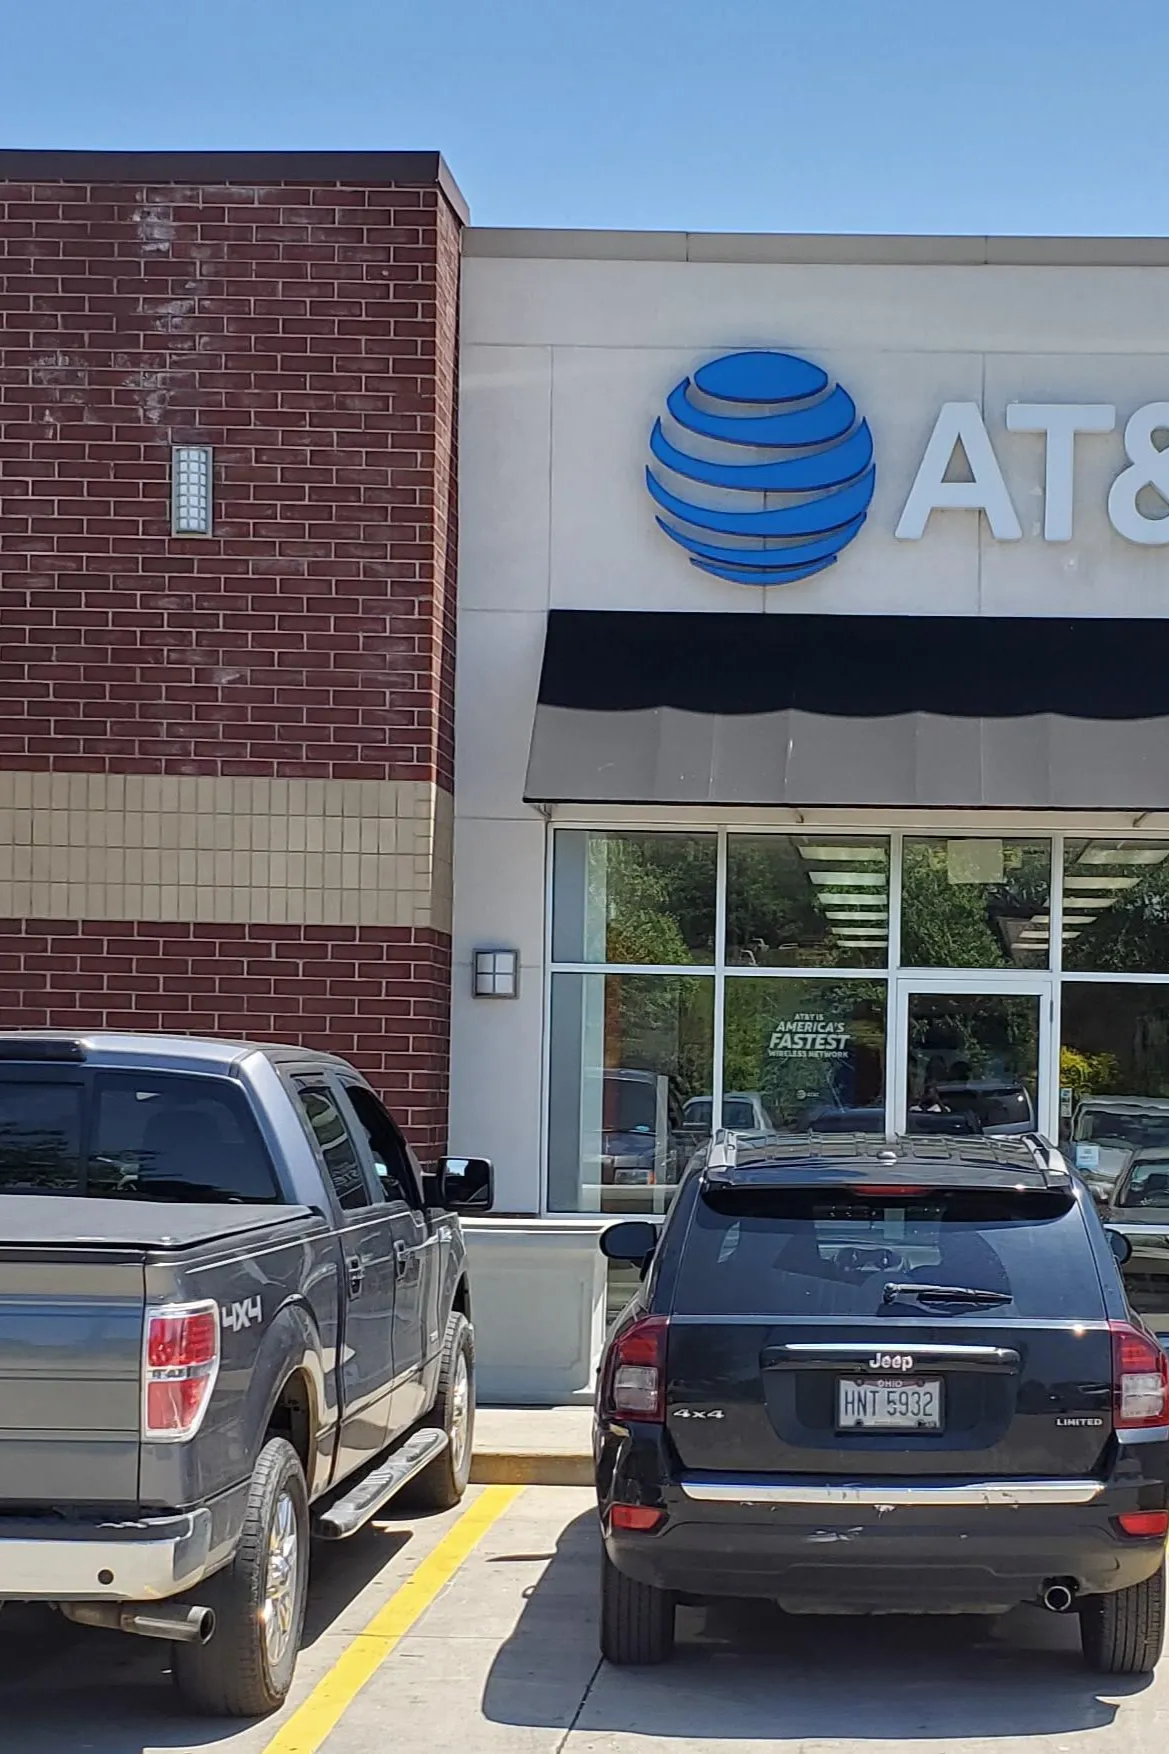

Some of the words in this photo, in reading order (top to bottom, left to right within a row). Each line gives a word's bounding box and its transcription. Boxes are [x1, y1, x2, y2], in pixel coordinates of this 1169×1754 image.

[776, 1021, 846, 1033] AMERICA'S
[769, 1033, 852, 1050] FASTEST
[768, 1049, 807, 1058] WIRELESS
[808, 1050, 849, 1059] NETWORK
[868, 1352, 914, 1372] Jeep
[877, 1379, 904, 1389] OHIO
[844, 1389, 880, 1416] HNT
[886, 1391, 934, 1417] 5932
[1055, 1418, 1103, 1427] LIMITED
